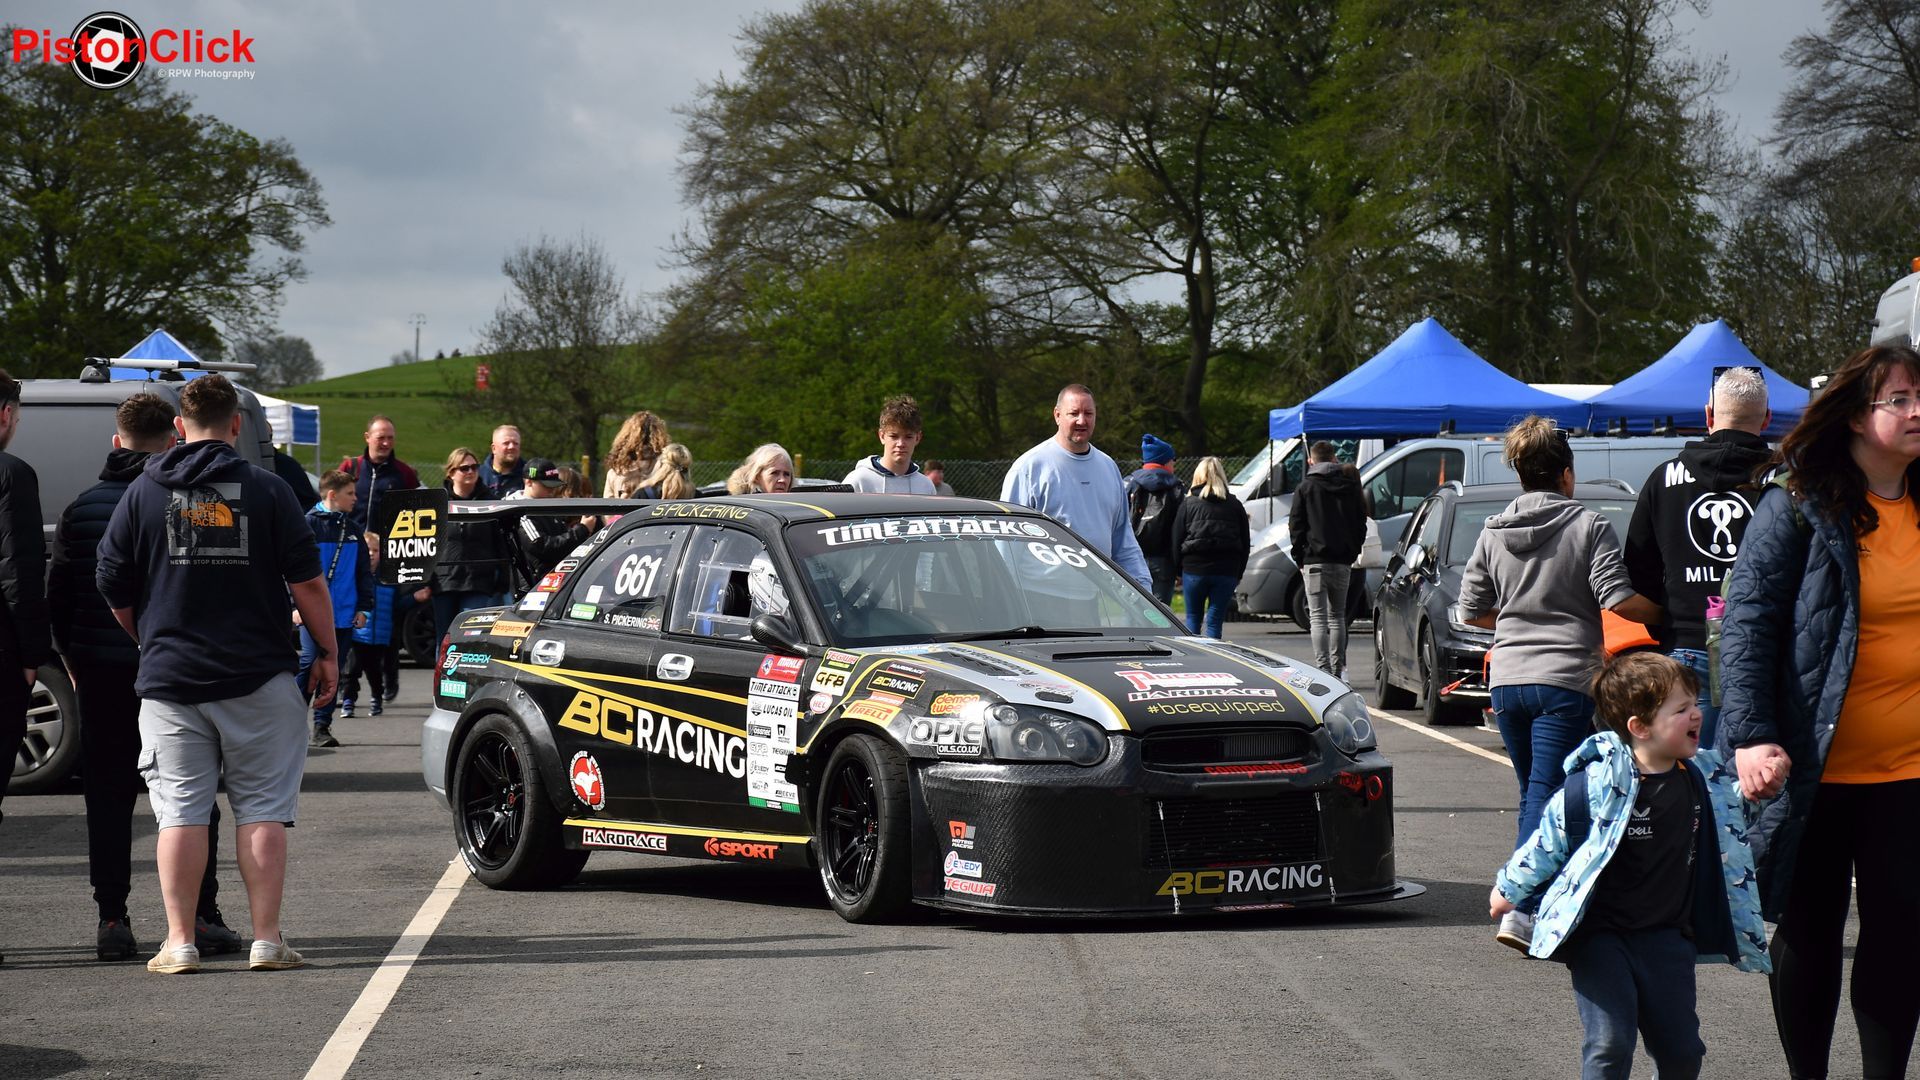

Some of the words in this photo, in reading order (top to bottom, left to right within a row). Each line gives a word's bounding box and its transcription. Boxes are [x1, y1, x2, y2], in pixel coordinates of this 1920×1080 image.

[181, 509, 215, 519] NORTH
[196, 502, 215, 510] THE
[192, 518, 216, 527] FACE
[389, 509, 437, 539] BC
[906, 519, 1025, 536] ATTACK
[388, 538, 436, 559] RACING
[1027, 542, 1110, 571] 661
[614, 553, 662, 597] 661
[611, 614, 648, 628] PICKERING
[816, 671, 845, 688] GFB
[872, 676, 891, 687] BC
[889, 678, 919, 693] RACING
[1131, 689, 1275, 700] HARDRACE
[763, 704, 782, 716] LUCAS
[783, 708, 793, 718] OIL
[813, 700, 826, 709] HEL
[848, 703, 893, 721] PIRELLI
[1146, 699, 1286, 716] #bcequipped
[557, 690, 634, 746] BC
[637, 708, 745, 779] RACING
[910, 720, 983, 745] OPIE
[938, 744, 980, 754] OILS.CO.UK
[1628, 826, 1653, 836] DELL
[585, 830, 665, 850] HARDRACE
[953, 860, 981, 872] EXEDY
[945, 878, 996, 896] TEGIWA
[1155, 871, 1225, 896] BC
[1227, 864, 1323, 893] RACING
